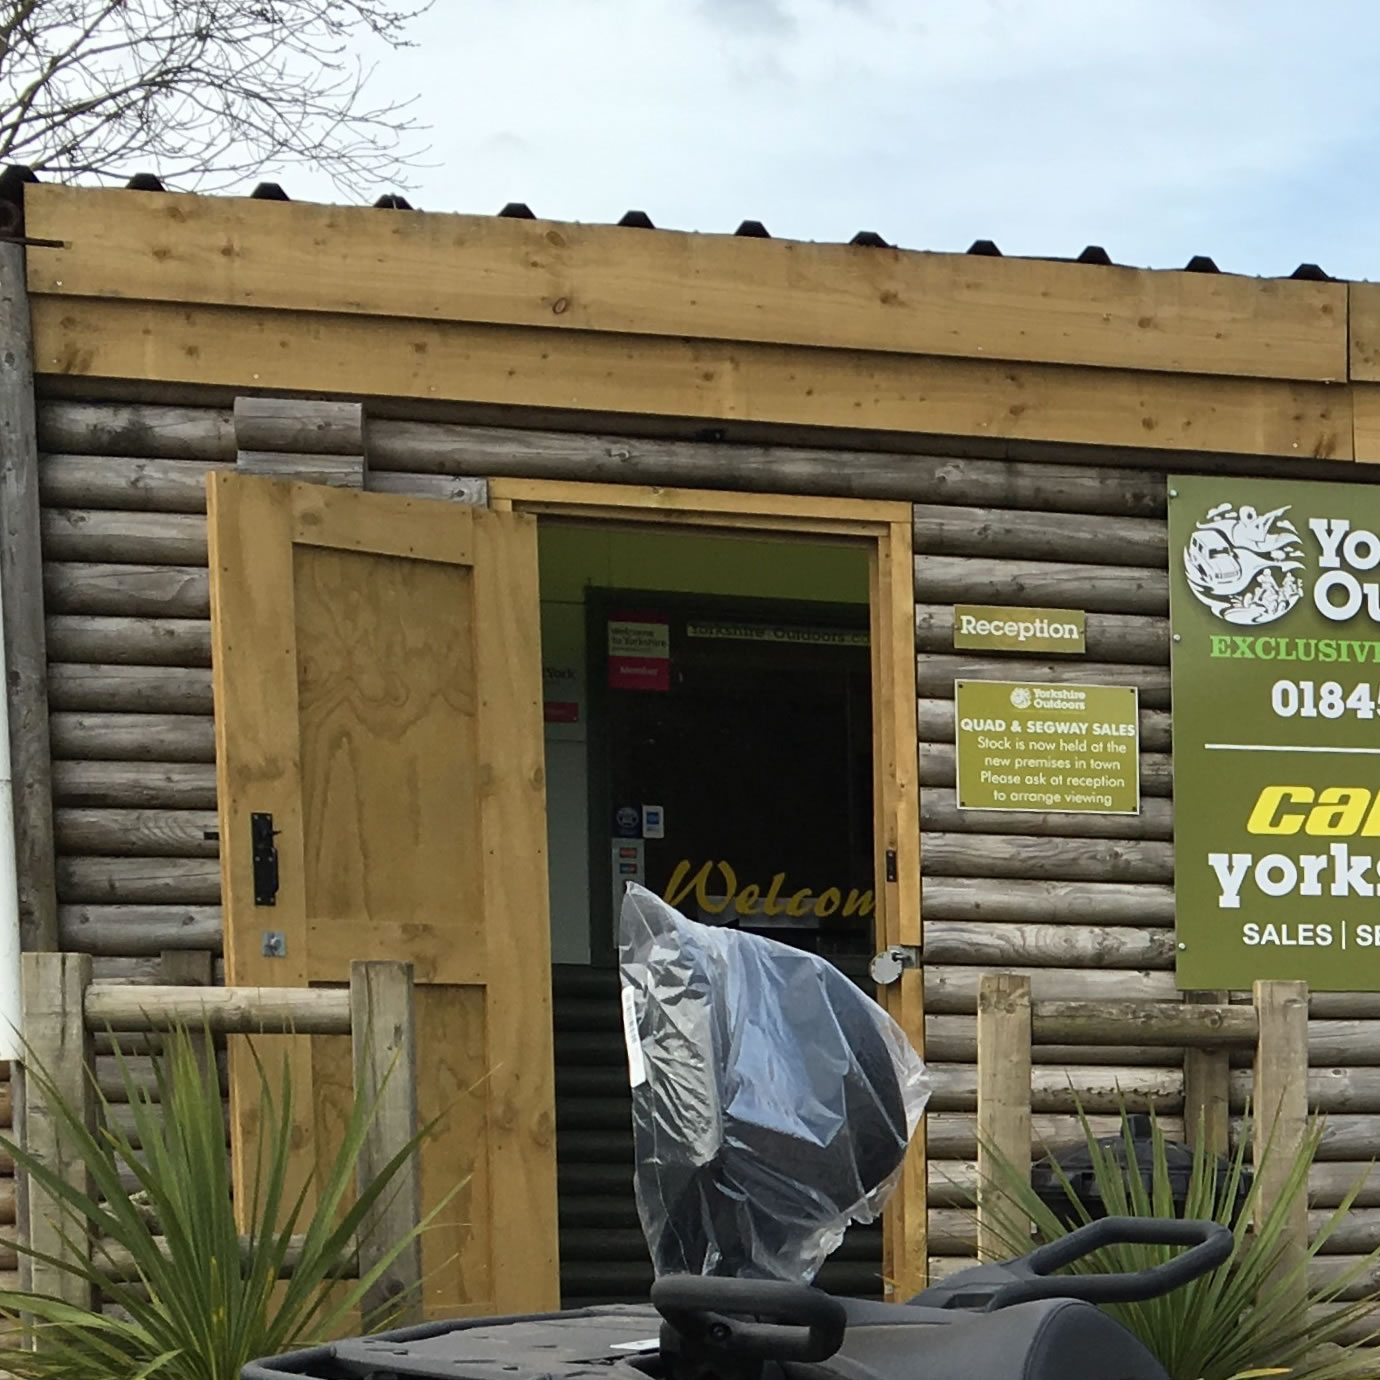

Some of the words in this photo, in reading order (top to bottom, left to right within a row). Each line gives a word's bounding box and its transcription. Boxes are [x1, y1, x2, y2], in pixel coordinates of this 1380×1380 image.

[690, 624, 765, 639] Yorkshire
[960, 616, 1079, 640] Reception
[1033, 688, 1086, 700] Yorkshire
[1033, 699, 1086, 710] Outdoors
[960, 718, 1006, 732] QUAD
[1010, 720, 1022, 733] &
[1026, 721, 1089, 735] SEGWAY
[1092, 723, 1136, 736] SALES
[977, 736, 1012, 750] Stock
[1016, 738, 1025, 750] is
[1029, 740, 1056, 751] now
[1059, 739, 1087, 752] held
[1091, 742, 1104, 753] at
[1107, 741, 1127, 754] the
[984, 757, 1010, 767] new
[1014, 757, 1071, 770] premises
[1075, 757, 1086, 769] in
[1090, 759, 1121, 771] town
[980, 771, 1021, 785] Please
[1024, 773, 1046, 785] ask
[1050, 775, 1063, 786] at
[1067, 775, 1125, 789] reception
[993, 790, 1007, 800] to
[1010, 793, 1061, 805] arrange
[1064, 791, 1113, 807] viewing
[1242, 922, 1333, 946] SALES
